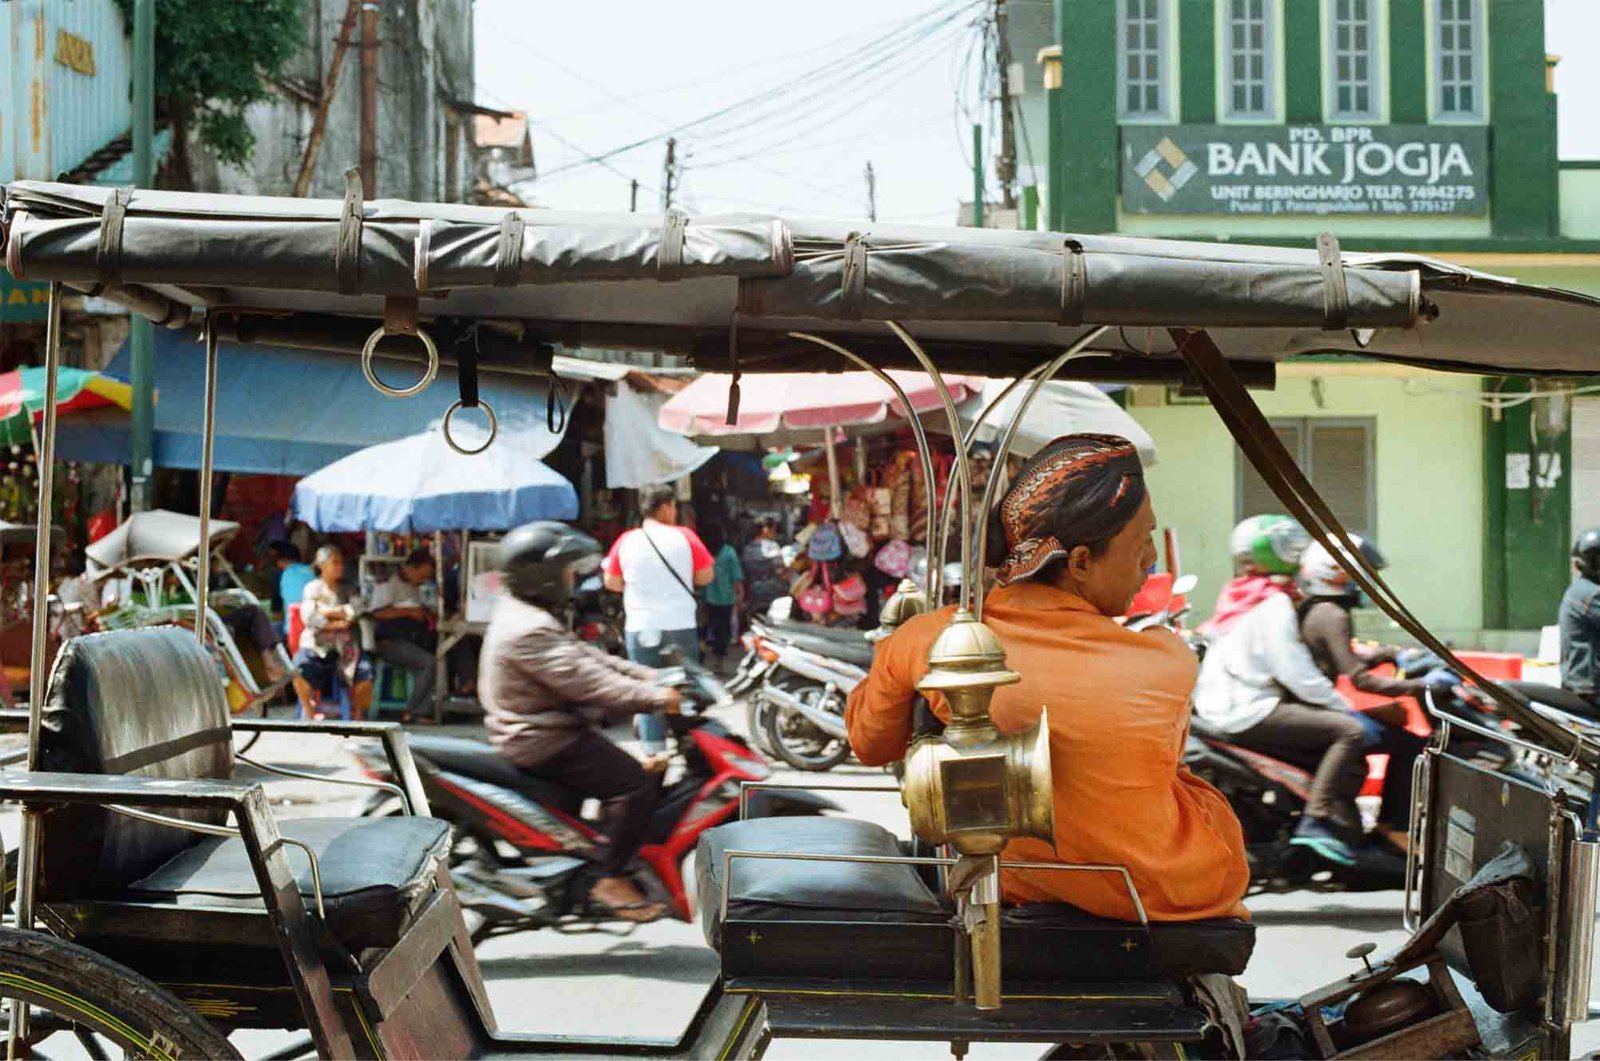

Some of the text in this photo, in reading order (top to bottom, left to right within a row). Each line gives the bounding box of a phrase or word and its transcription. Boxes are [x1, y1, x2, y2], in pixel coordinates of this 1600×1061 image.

[1290, 127, 1373, 142] PD. BPR
[1207, 142, 1473, 183] BANK JOGJA
[1210, 184, 1250, 200] UNIT
